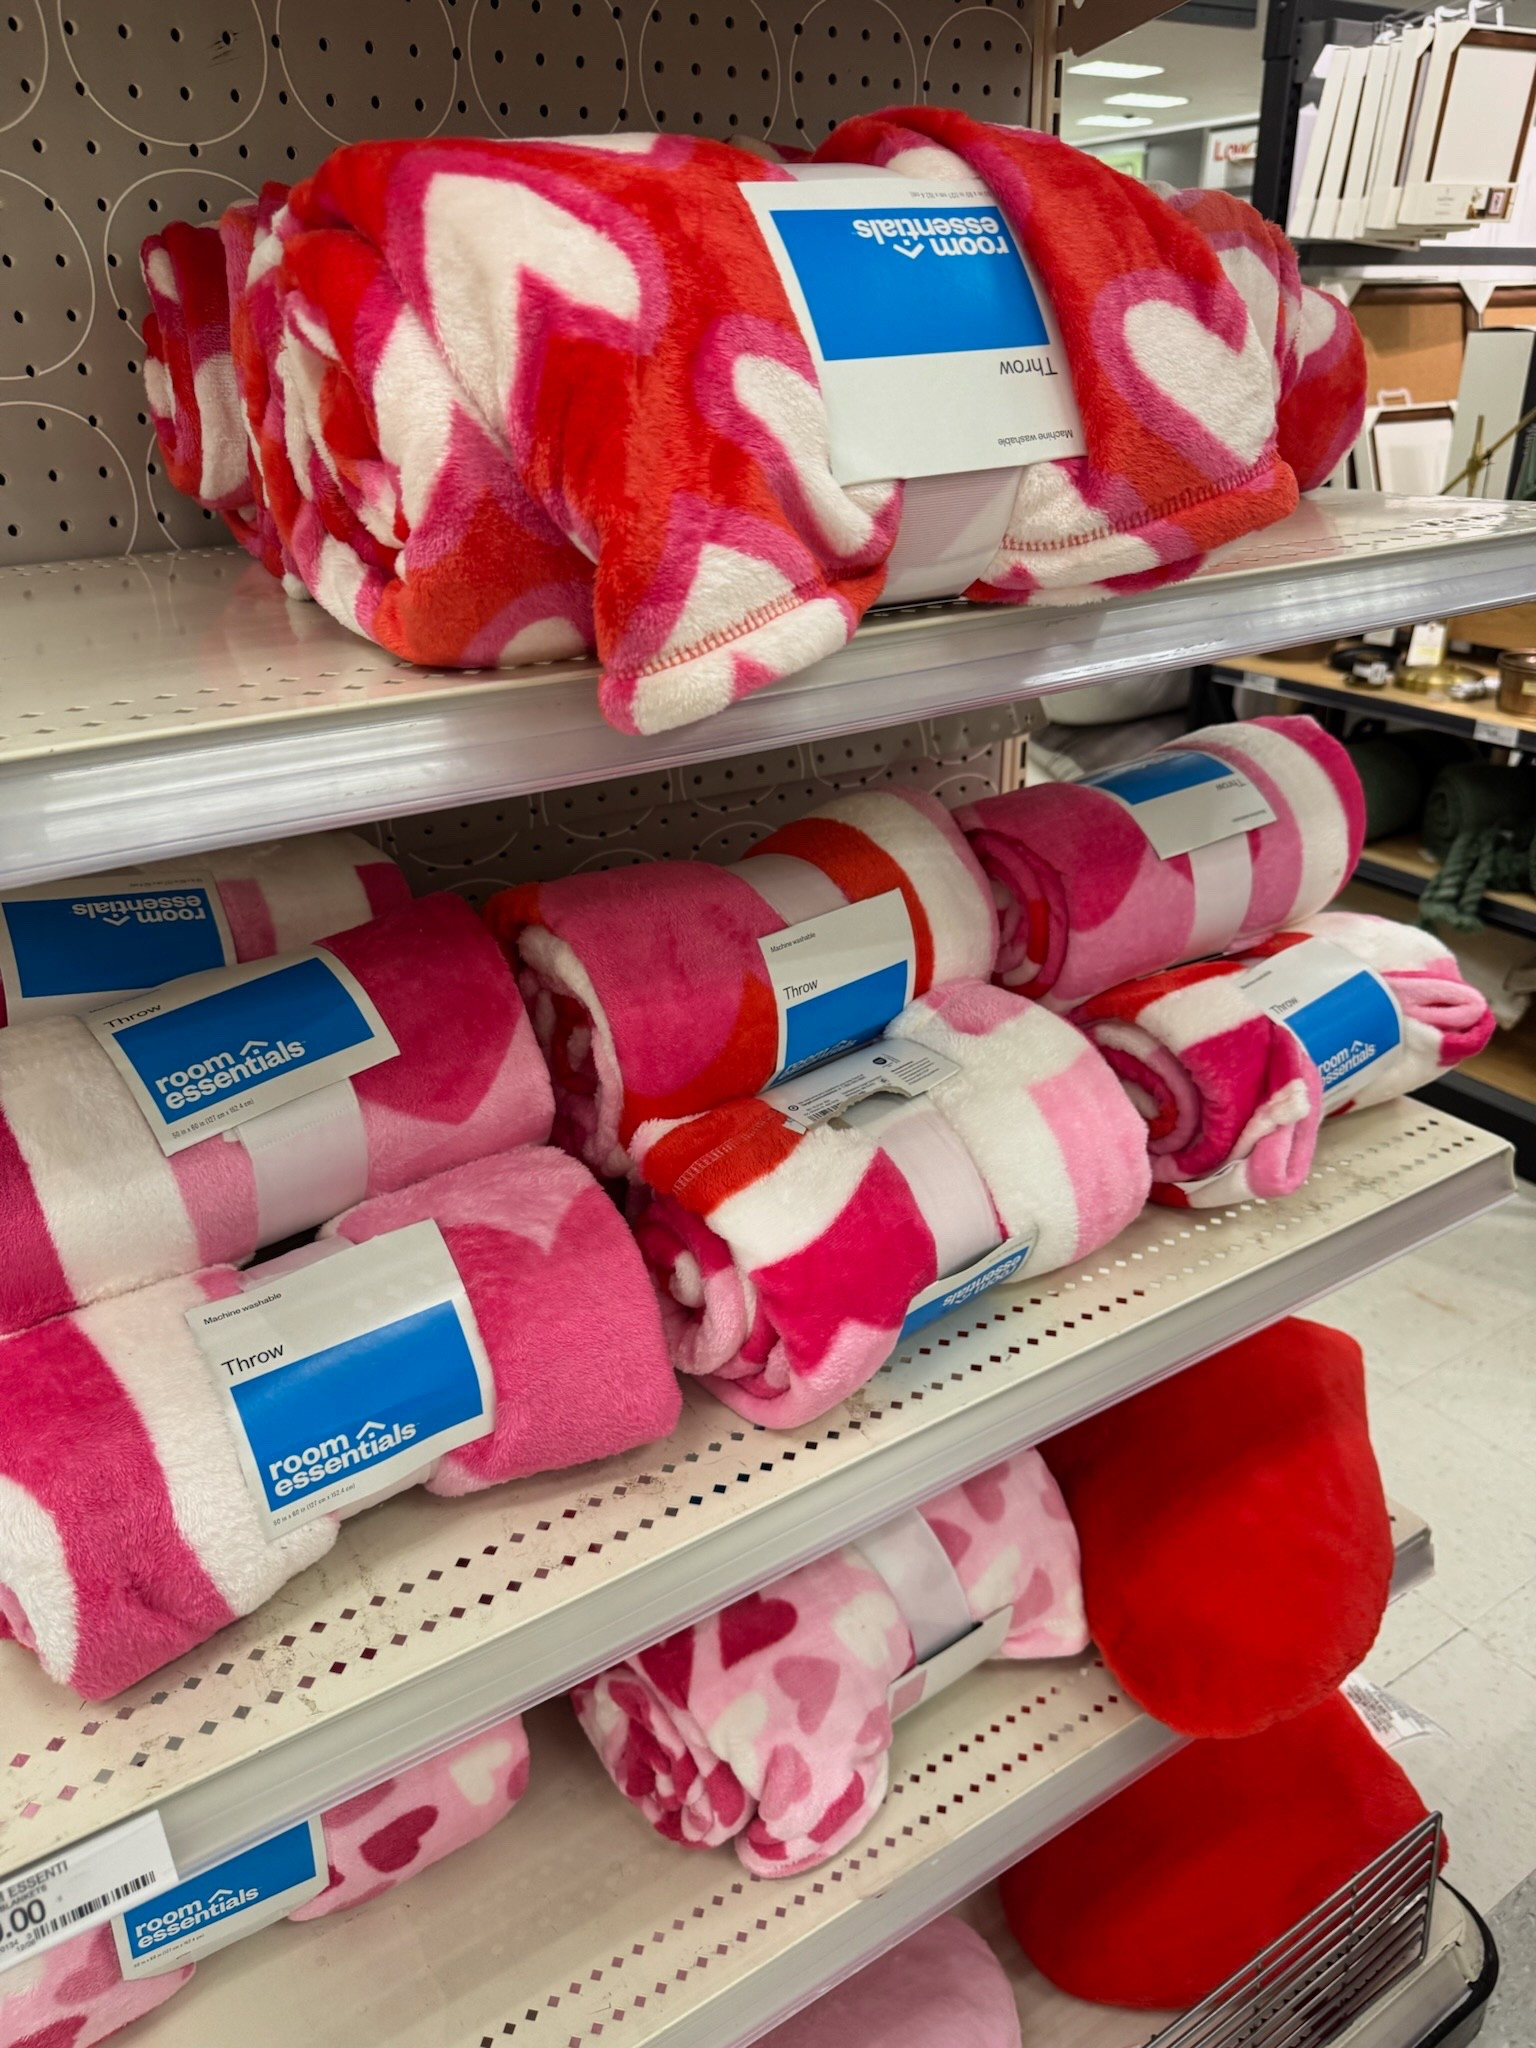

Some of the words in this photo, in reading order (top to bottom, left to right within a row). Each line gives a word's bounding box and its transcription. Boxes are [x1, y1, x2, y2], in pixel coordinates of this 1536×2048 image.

[853, 217, 999, 244] essentials
[932, 236, 1009, 257] room
[1000, 357, 1058, 377] Throw
[998, 434, 1037, 447] washable
[1038, 429, 1073, 441] Machine
[1215, 778, 1246, 791] Throw
[72, 895, 201, 919] essentials
[136, 907, 206, 923] room
[783, 977, 818, 1001] Throw
[104, 1003, 162, 1030] Throw
[1269, 996, 1298, 1016] Throw
[154, 1050, 234, 1095] room
[1319, 1047, 1349, 1076] room
[165, 1040, 305, 1111] essentials
[203, 1307, 240, 1325] Machine
[240, 1292, 282, 1312] washable
[221, 1343, 285, 1377] Throw
[268, 1432, 348, 1480] room
[274, 1421, 416, 1498] essentials
[8, 1860, 68, 1897] ESSENTI
[136, 1900, 202, 1937] room
[138, 1886, 258, 1950] essentials
